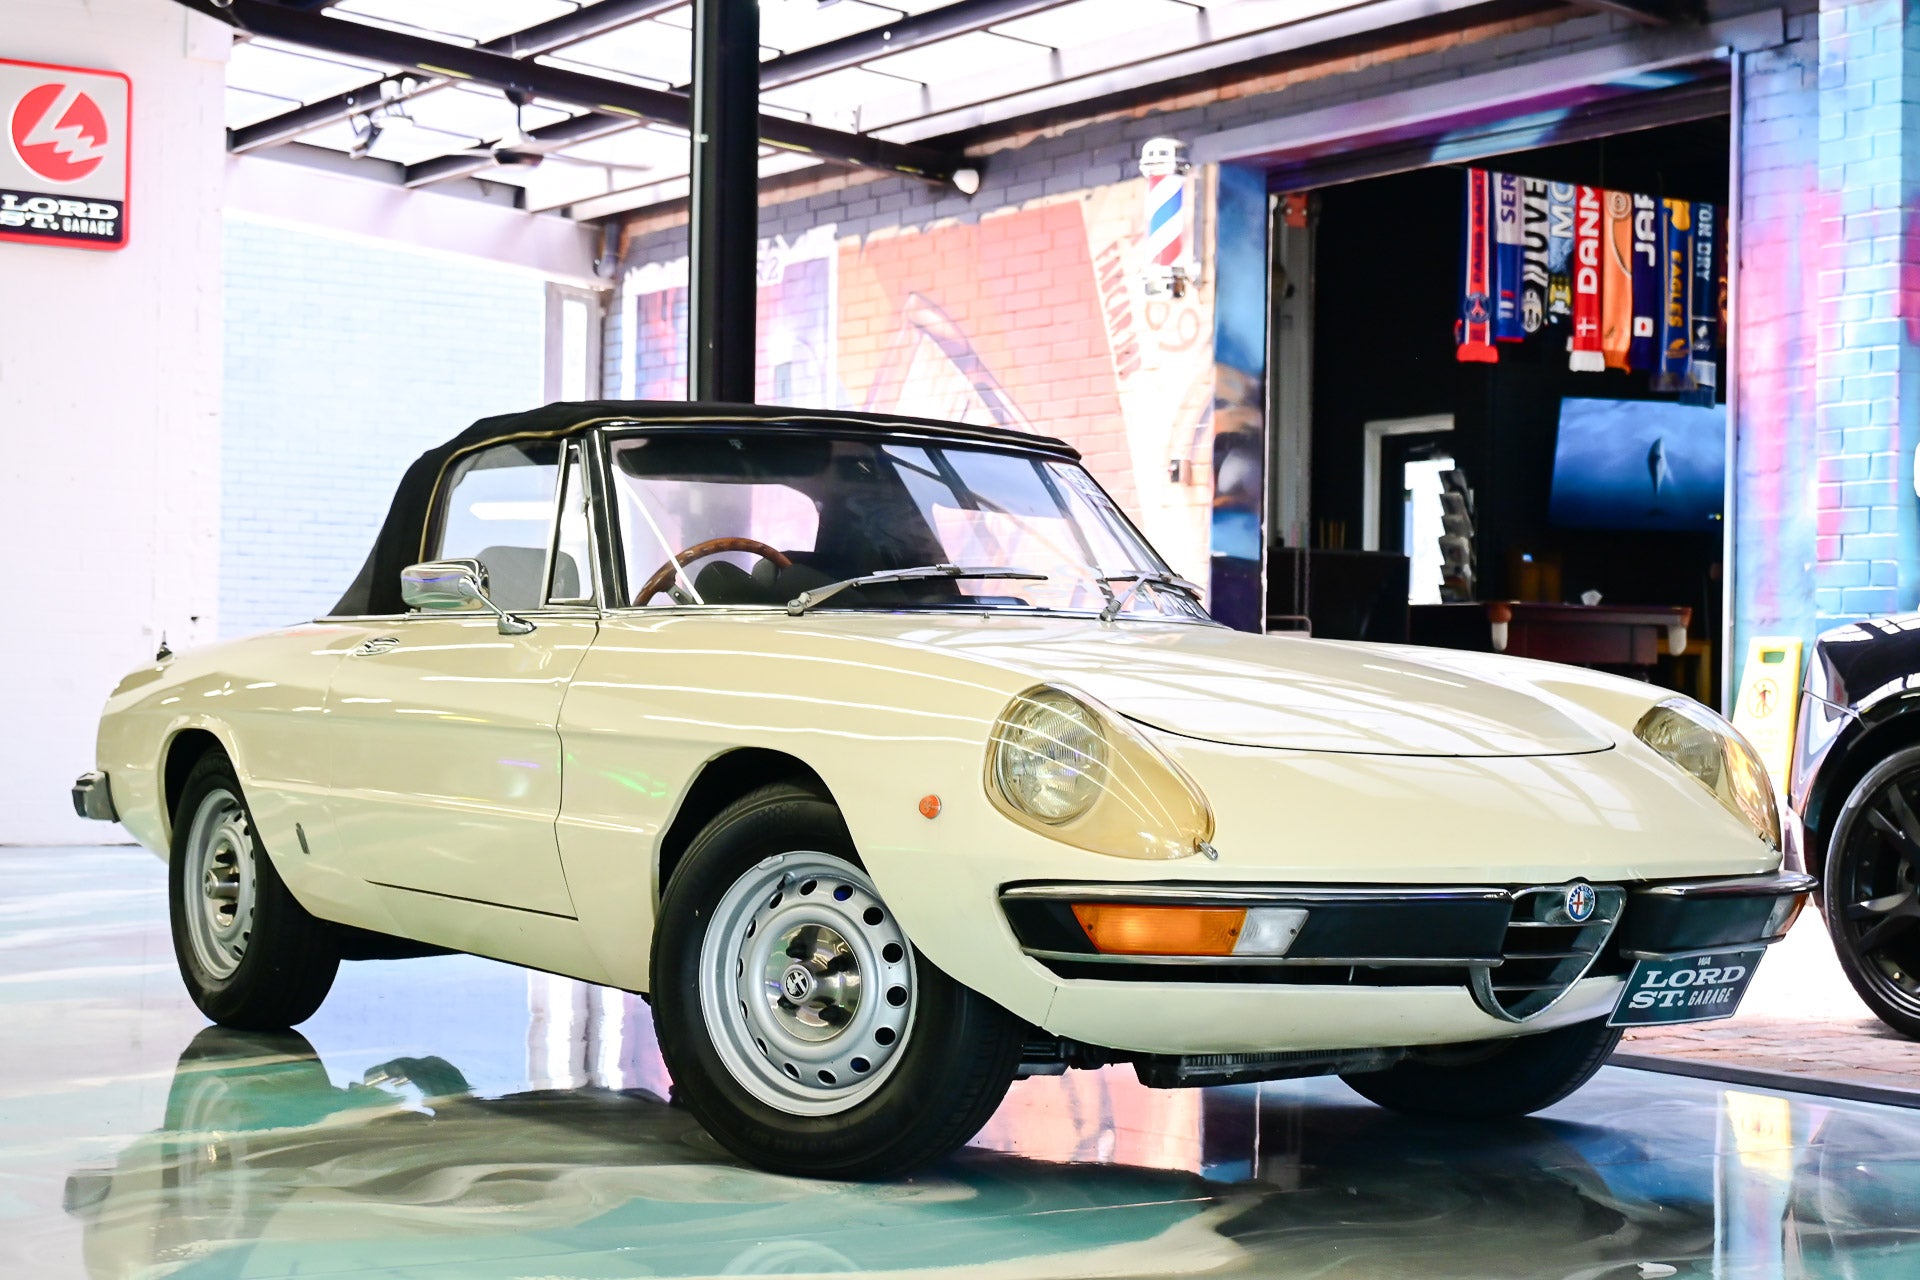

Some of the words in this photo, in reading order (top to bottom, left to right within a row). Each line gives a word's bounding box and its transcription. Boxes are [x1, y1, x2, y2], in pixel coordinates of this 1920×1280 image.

[1, 194, 119, 220] LORD
[0, 210, 60, 230] ST.
[62, 217, 115, 236] GARAGE
[1696, 241, 1712, 281] DRY
[1669, 249, 1684, 328] EAGLES
[1641, 965, 1746, 988] LORD
[1628, 989, 1685, 1009] ST.
[1688, 987, 1734, 1006] GARAGE
